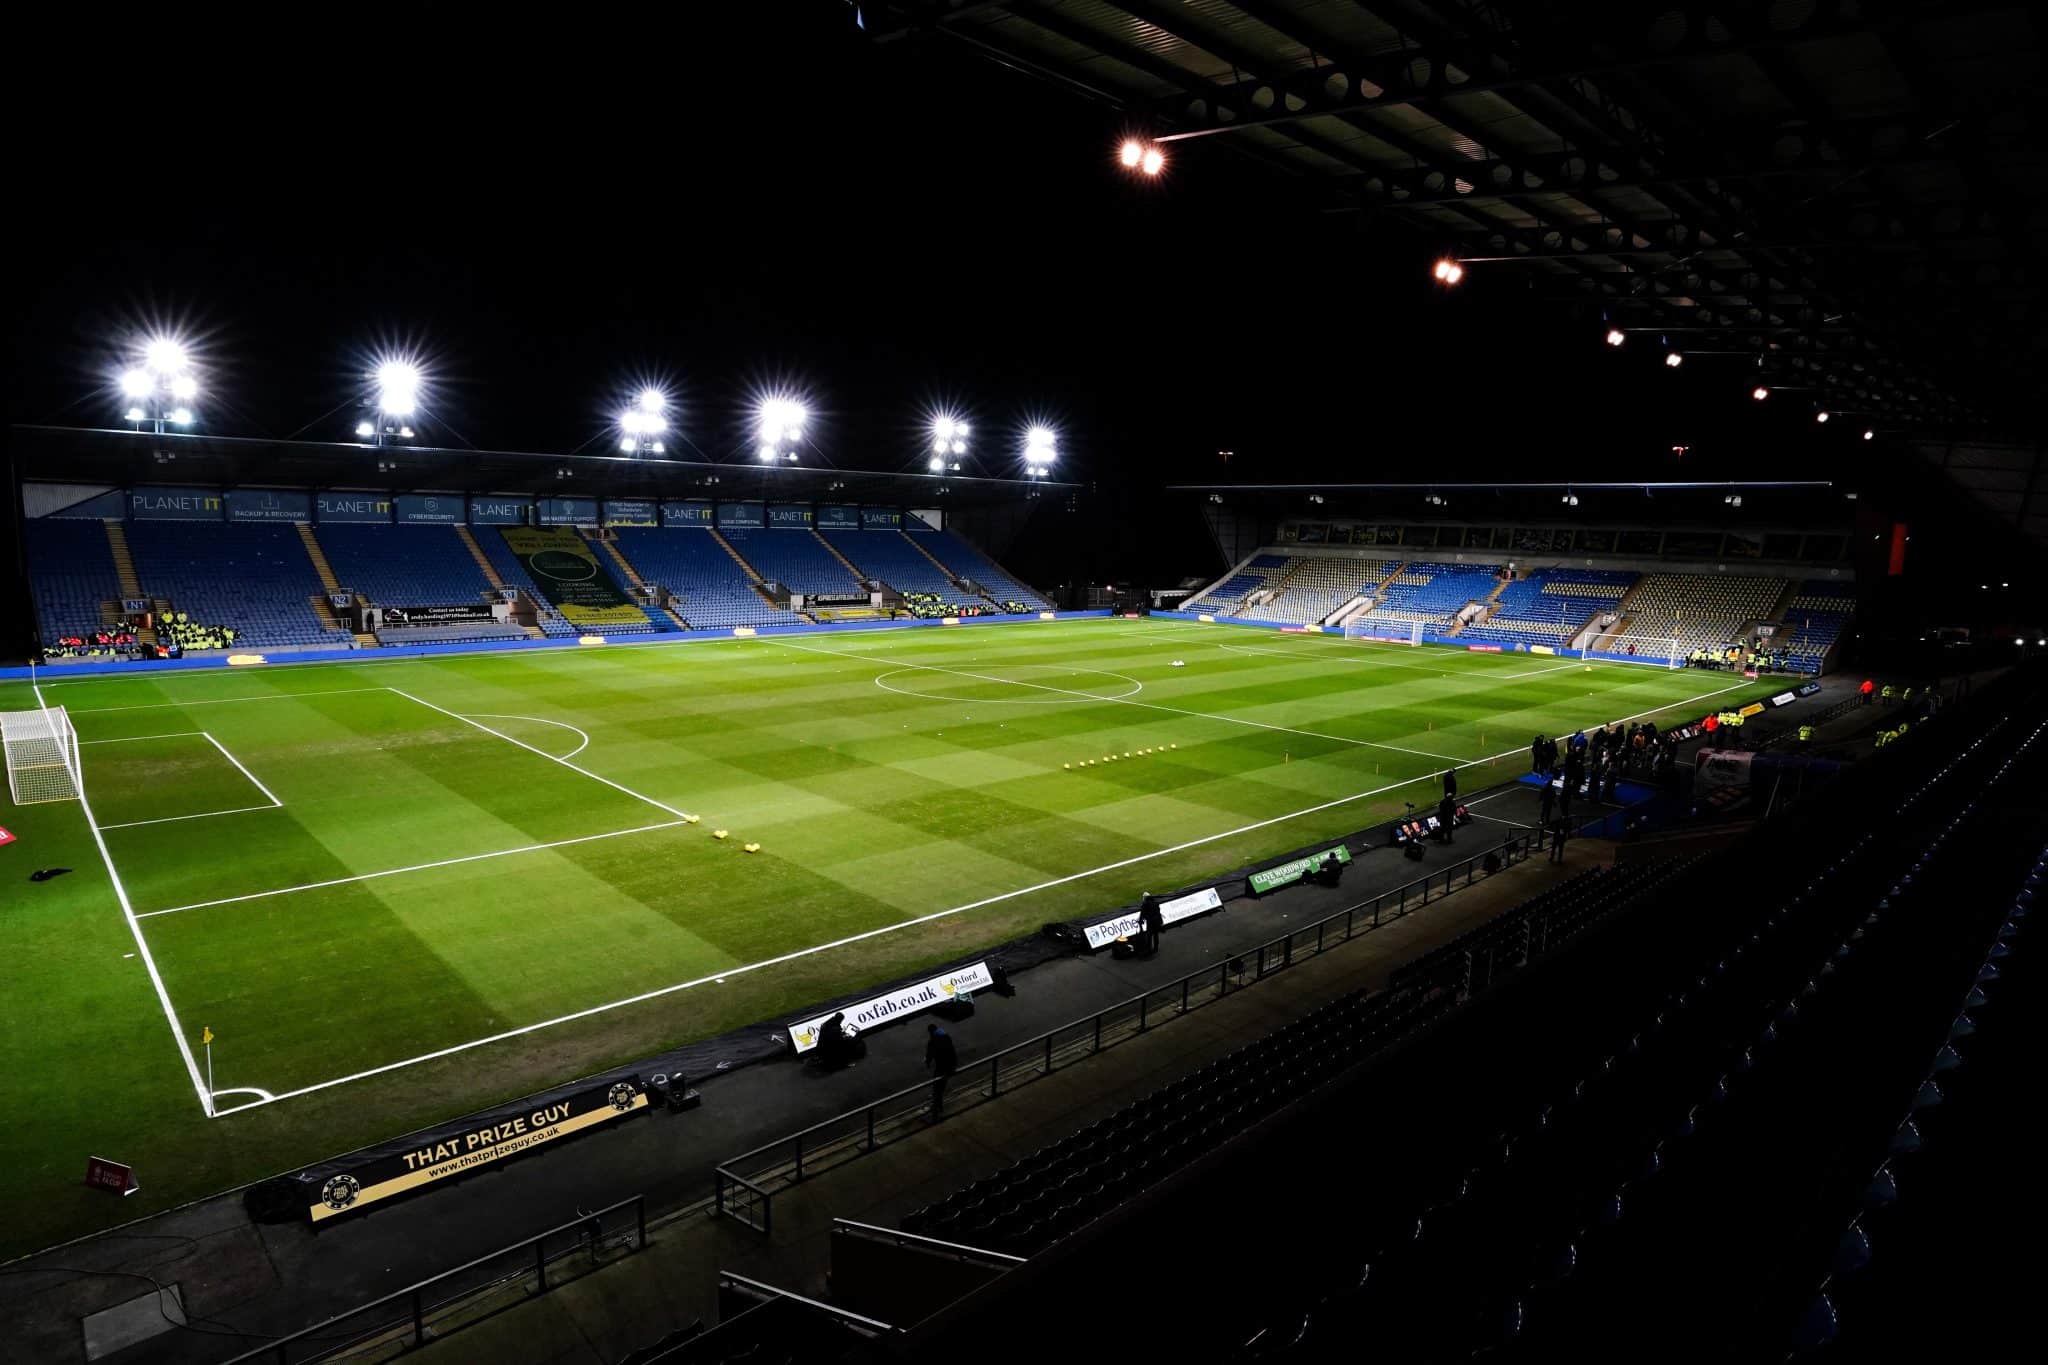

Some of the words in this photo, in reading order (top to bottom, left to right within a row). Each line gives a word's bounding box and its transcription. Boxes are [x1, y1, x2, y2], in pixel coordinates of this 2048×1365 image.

[133, 496, 201, 511] PLANET
[204, 497, 221, 511] IT
[317, 500, 374, 513] PLANET
[376, 502, 390, 513] IT
[471, 503, 520, 516] PLANET
[663, 507, 701, 520] PLANET
[702, 509, 712, 520] IT
[803, 512, 813, 521] IT
[892, 514, 902, 525] IT
[1100, 919, 1139, 938] Polythe
[950, 971, 978, 987] Oxford
[857, 986, 937, 1023] oxfab.co.uk
[402, 1139, 459, 1169] THAT
[466, 1117, 527, 1150] PRIZE
[530, 1102, 571, 1127] GUY
[428, 1127, 560, 1178] www.thatprizeguy.co.uk
